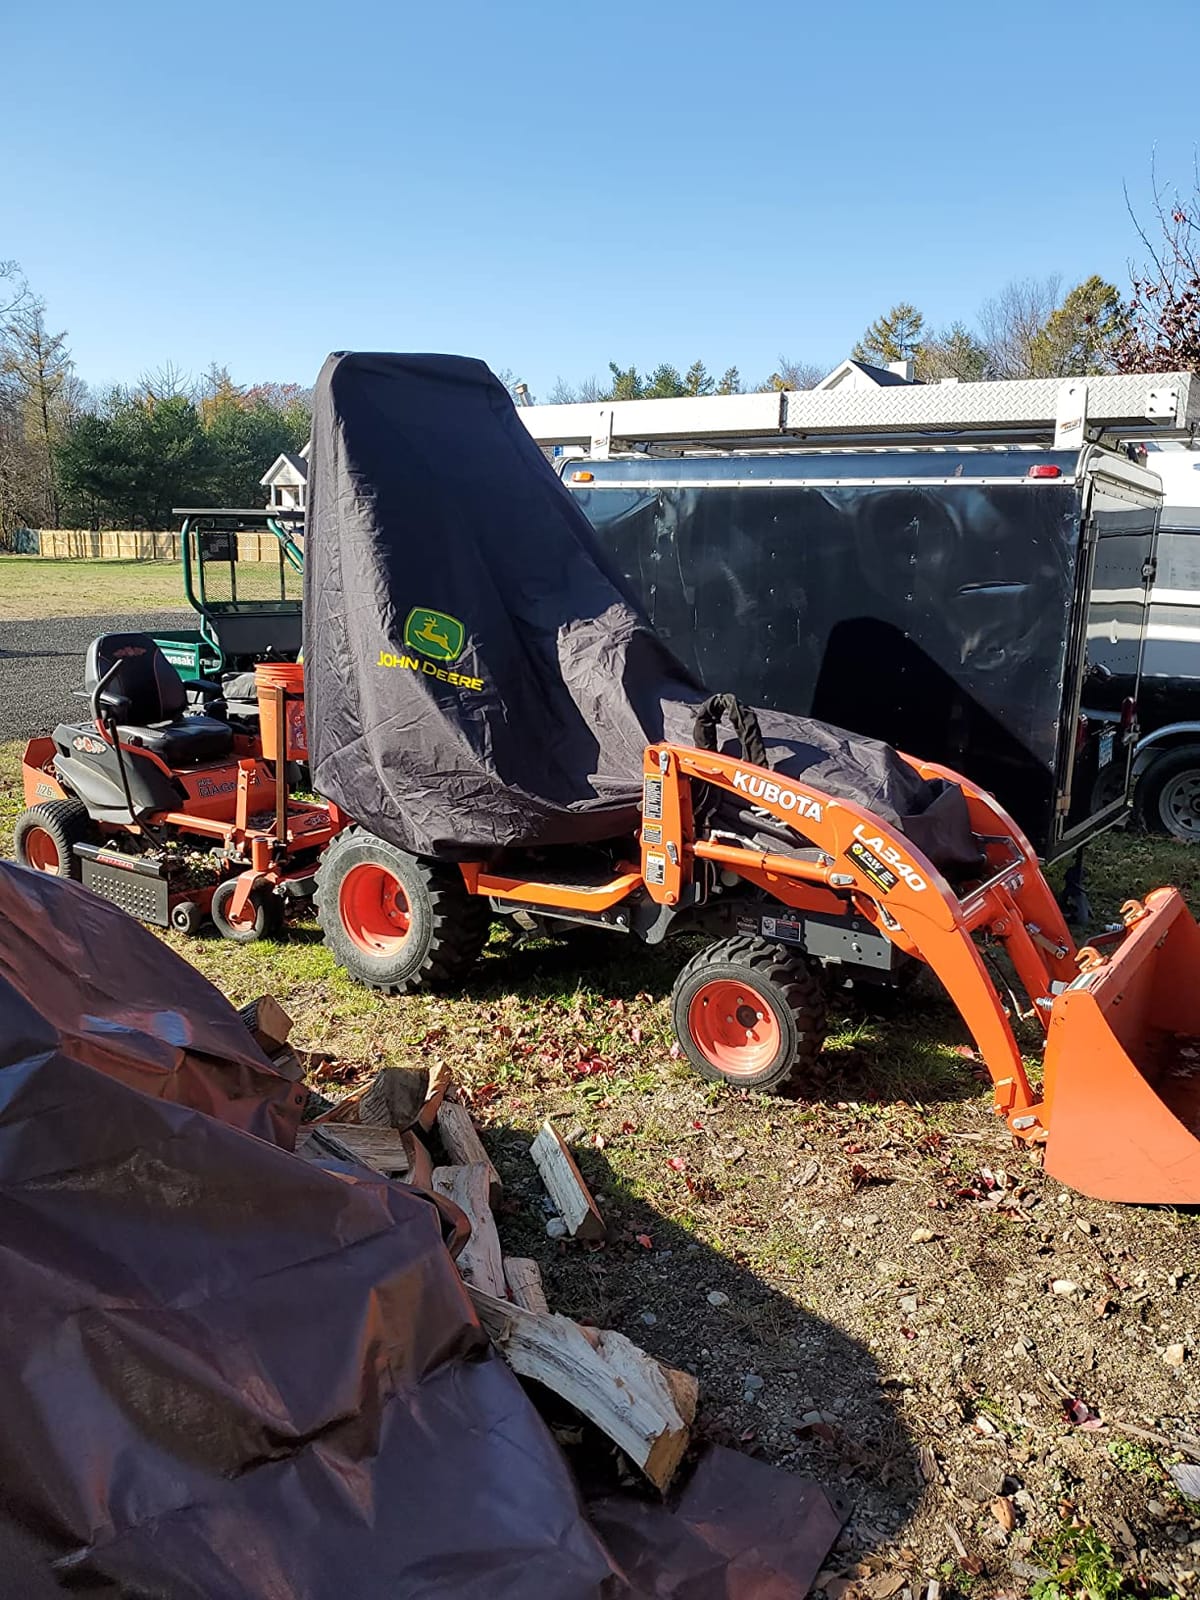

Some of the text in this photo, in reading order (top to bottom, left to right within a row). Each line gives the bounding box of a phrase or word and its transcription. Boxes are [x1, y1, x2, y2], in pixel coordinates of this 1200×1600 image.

[165, 655, 194, 667] wasaki
[376, 650, 485, 692] JOHN DEERE
[731, 769, 823, 823] KUBOTA
[852, 823, 928, 892] LA340
